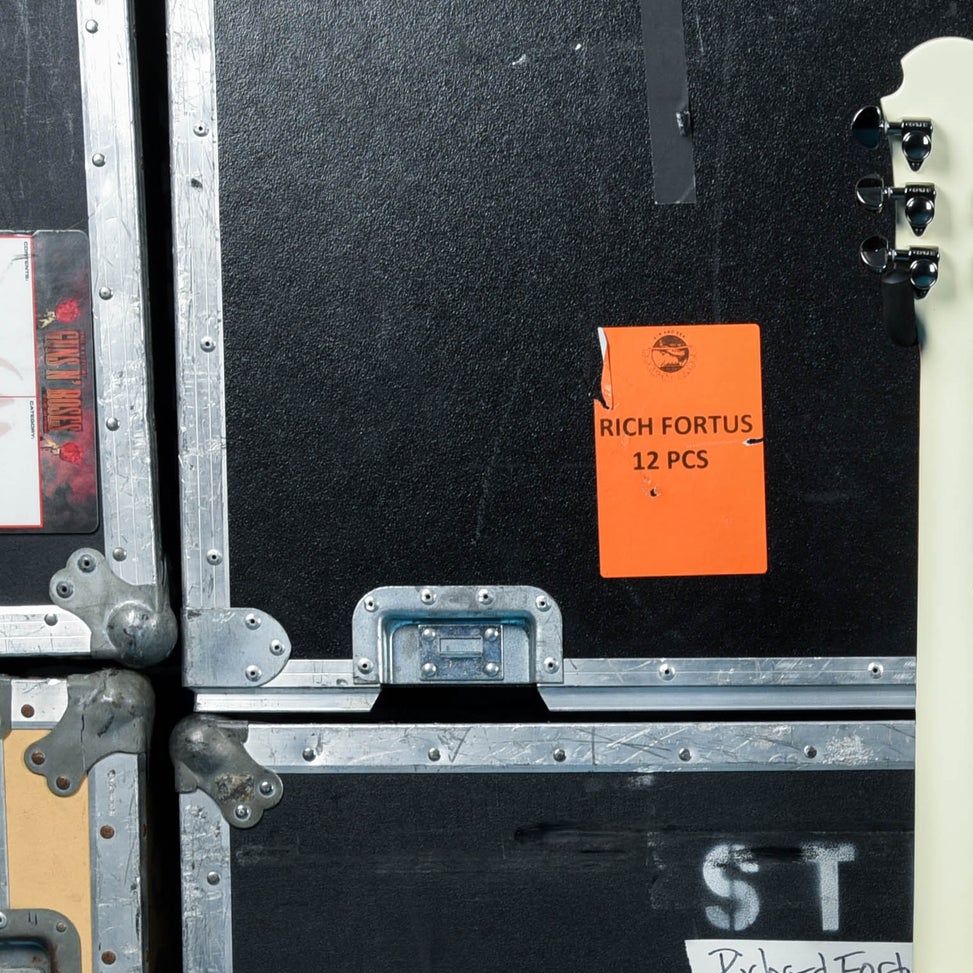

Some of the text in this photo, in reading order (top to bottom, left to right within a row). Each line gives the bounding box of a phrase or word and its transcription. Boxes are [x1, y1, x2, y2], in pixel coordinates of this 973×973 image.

[45, 330, 80, 365] GUNS
[46, 388, 82, 432] ROSES
[600, 414, 754, 437] RICH FORTUS
[633, 450, 709, 470] 12 PCS
